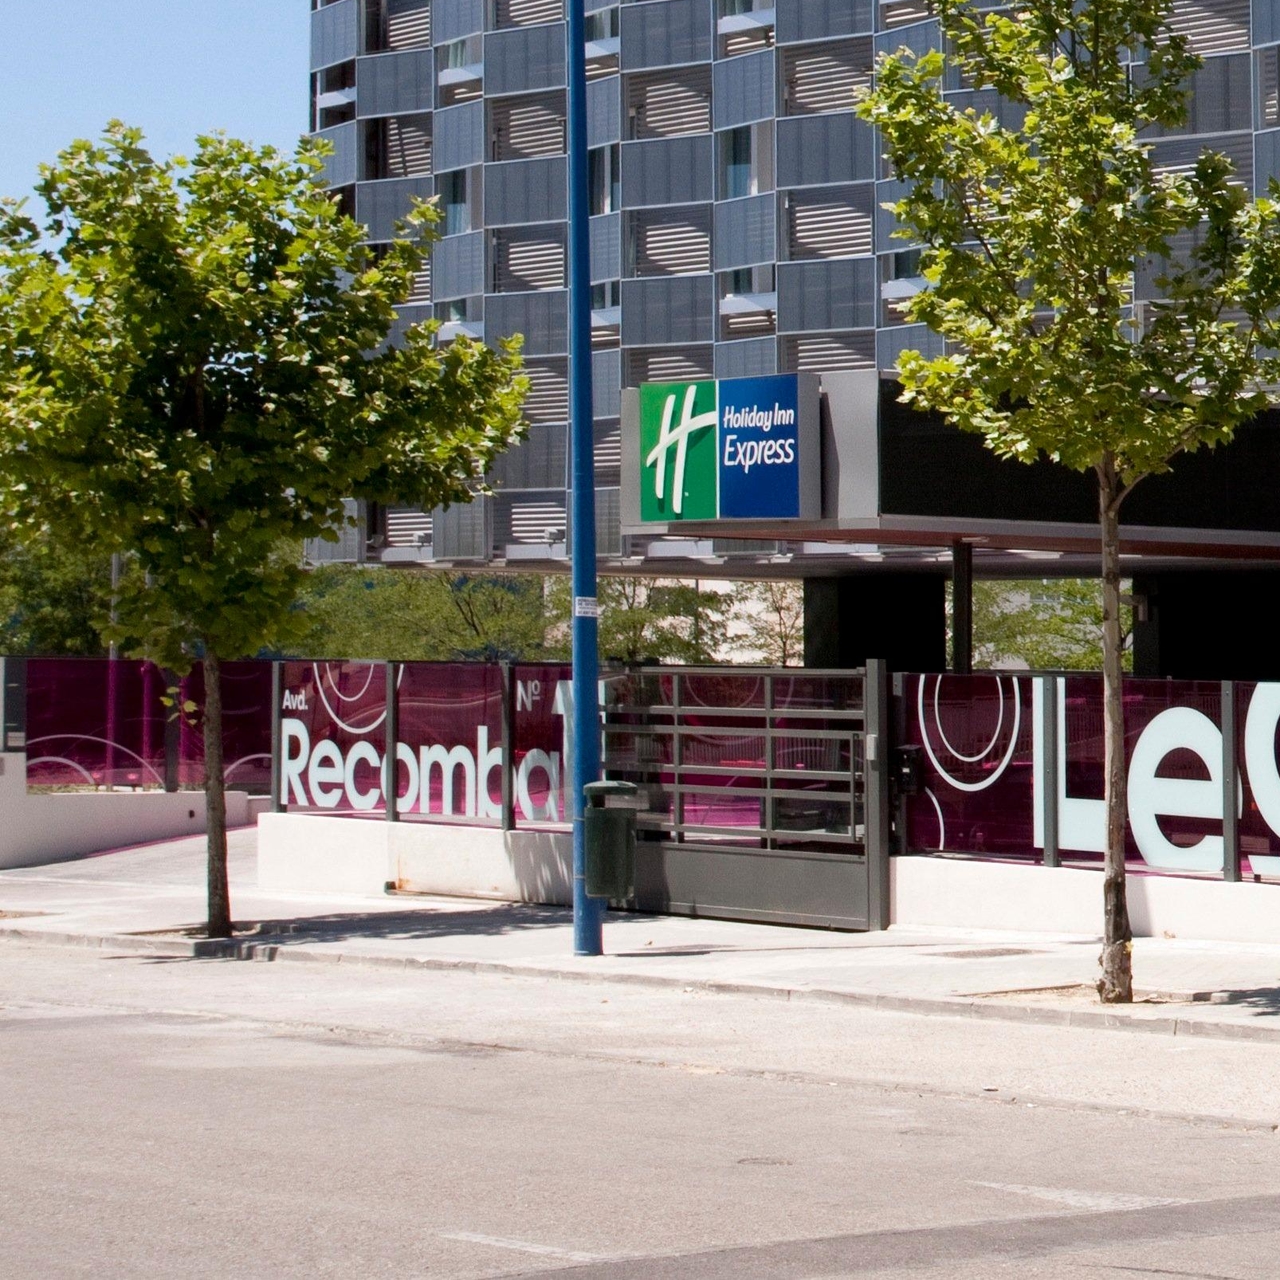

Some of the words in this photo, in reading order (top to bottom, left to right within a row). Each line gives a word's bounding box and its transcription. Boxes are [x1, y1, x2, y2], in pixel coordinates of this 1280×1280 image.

[723, 404, 773, 432] Holiday
[774, 402, 794, 426] Inn
[723, 435, 795, 474] Express
[282, 689, 309, 710] Avd.
[281, 719, 560, 822] Recomba
